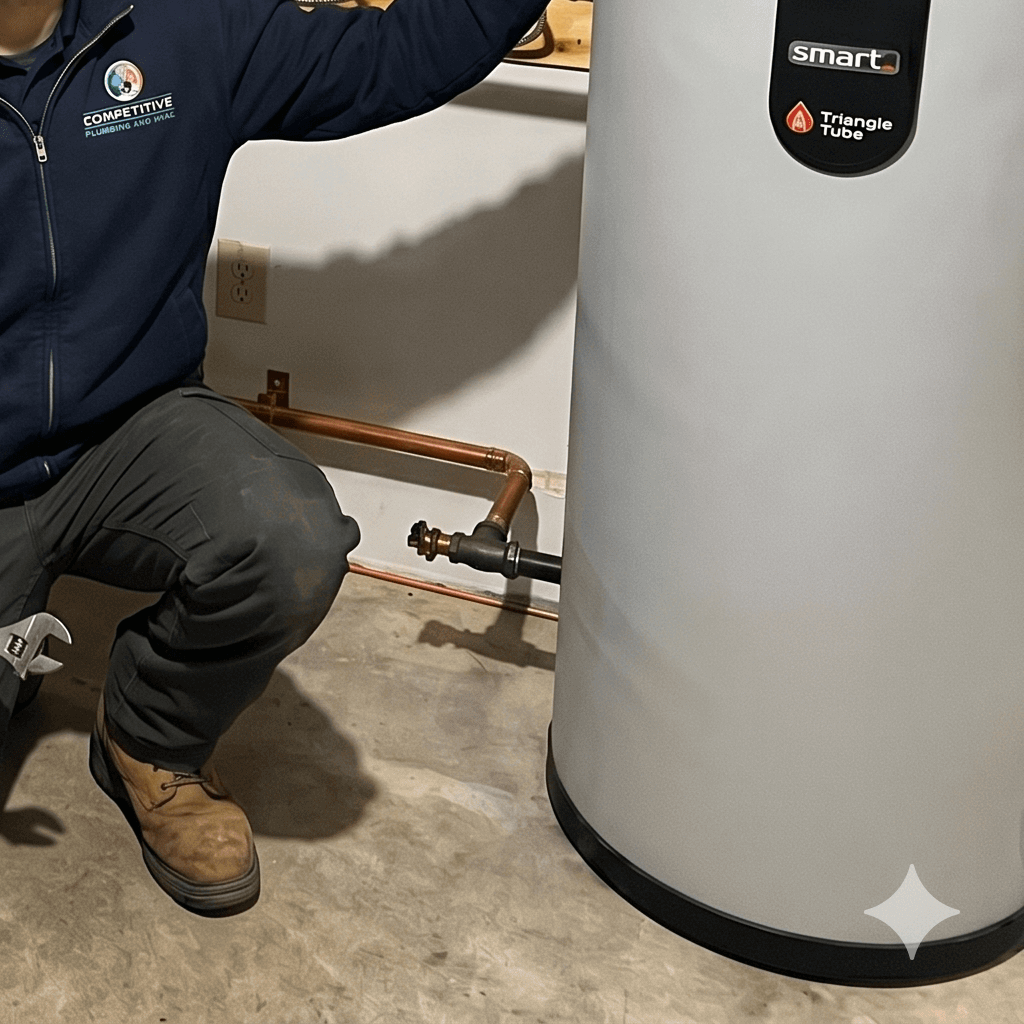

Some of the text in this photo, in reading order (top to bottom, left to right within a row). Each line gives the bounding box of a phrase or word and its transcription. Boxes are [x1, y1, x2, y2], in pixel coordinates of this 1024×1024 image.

[792, 45, 882, 70] smart
[83, 96, 173, 127] COMPETITIVE
[820, 110, 893, 132] Triangle
[85, 122, 131, 138] PLUMBING
[819, 123, 864, 141] Tube
